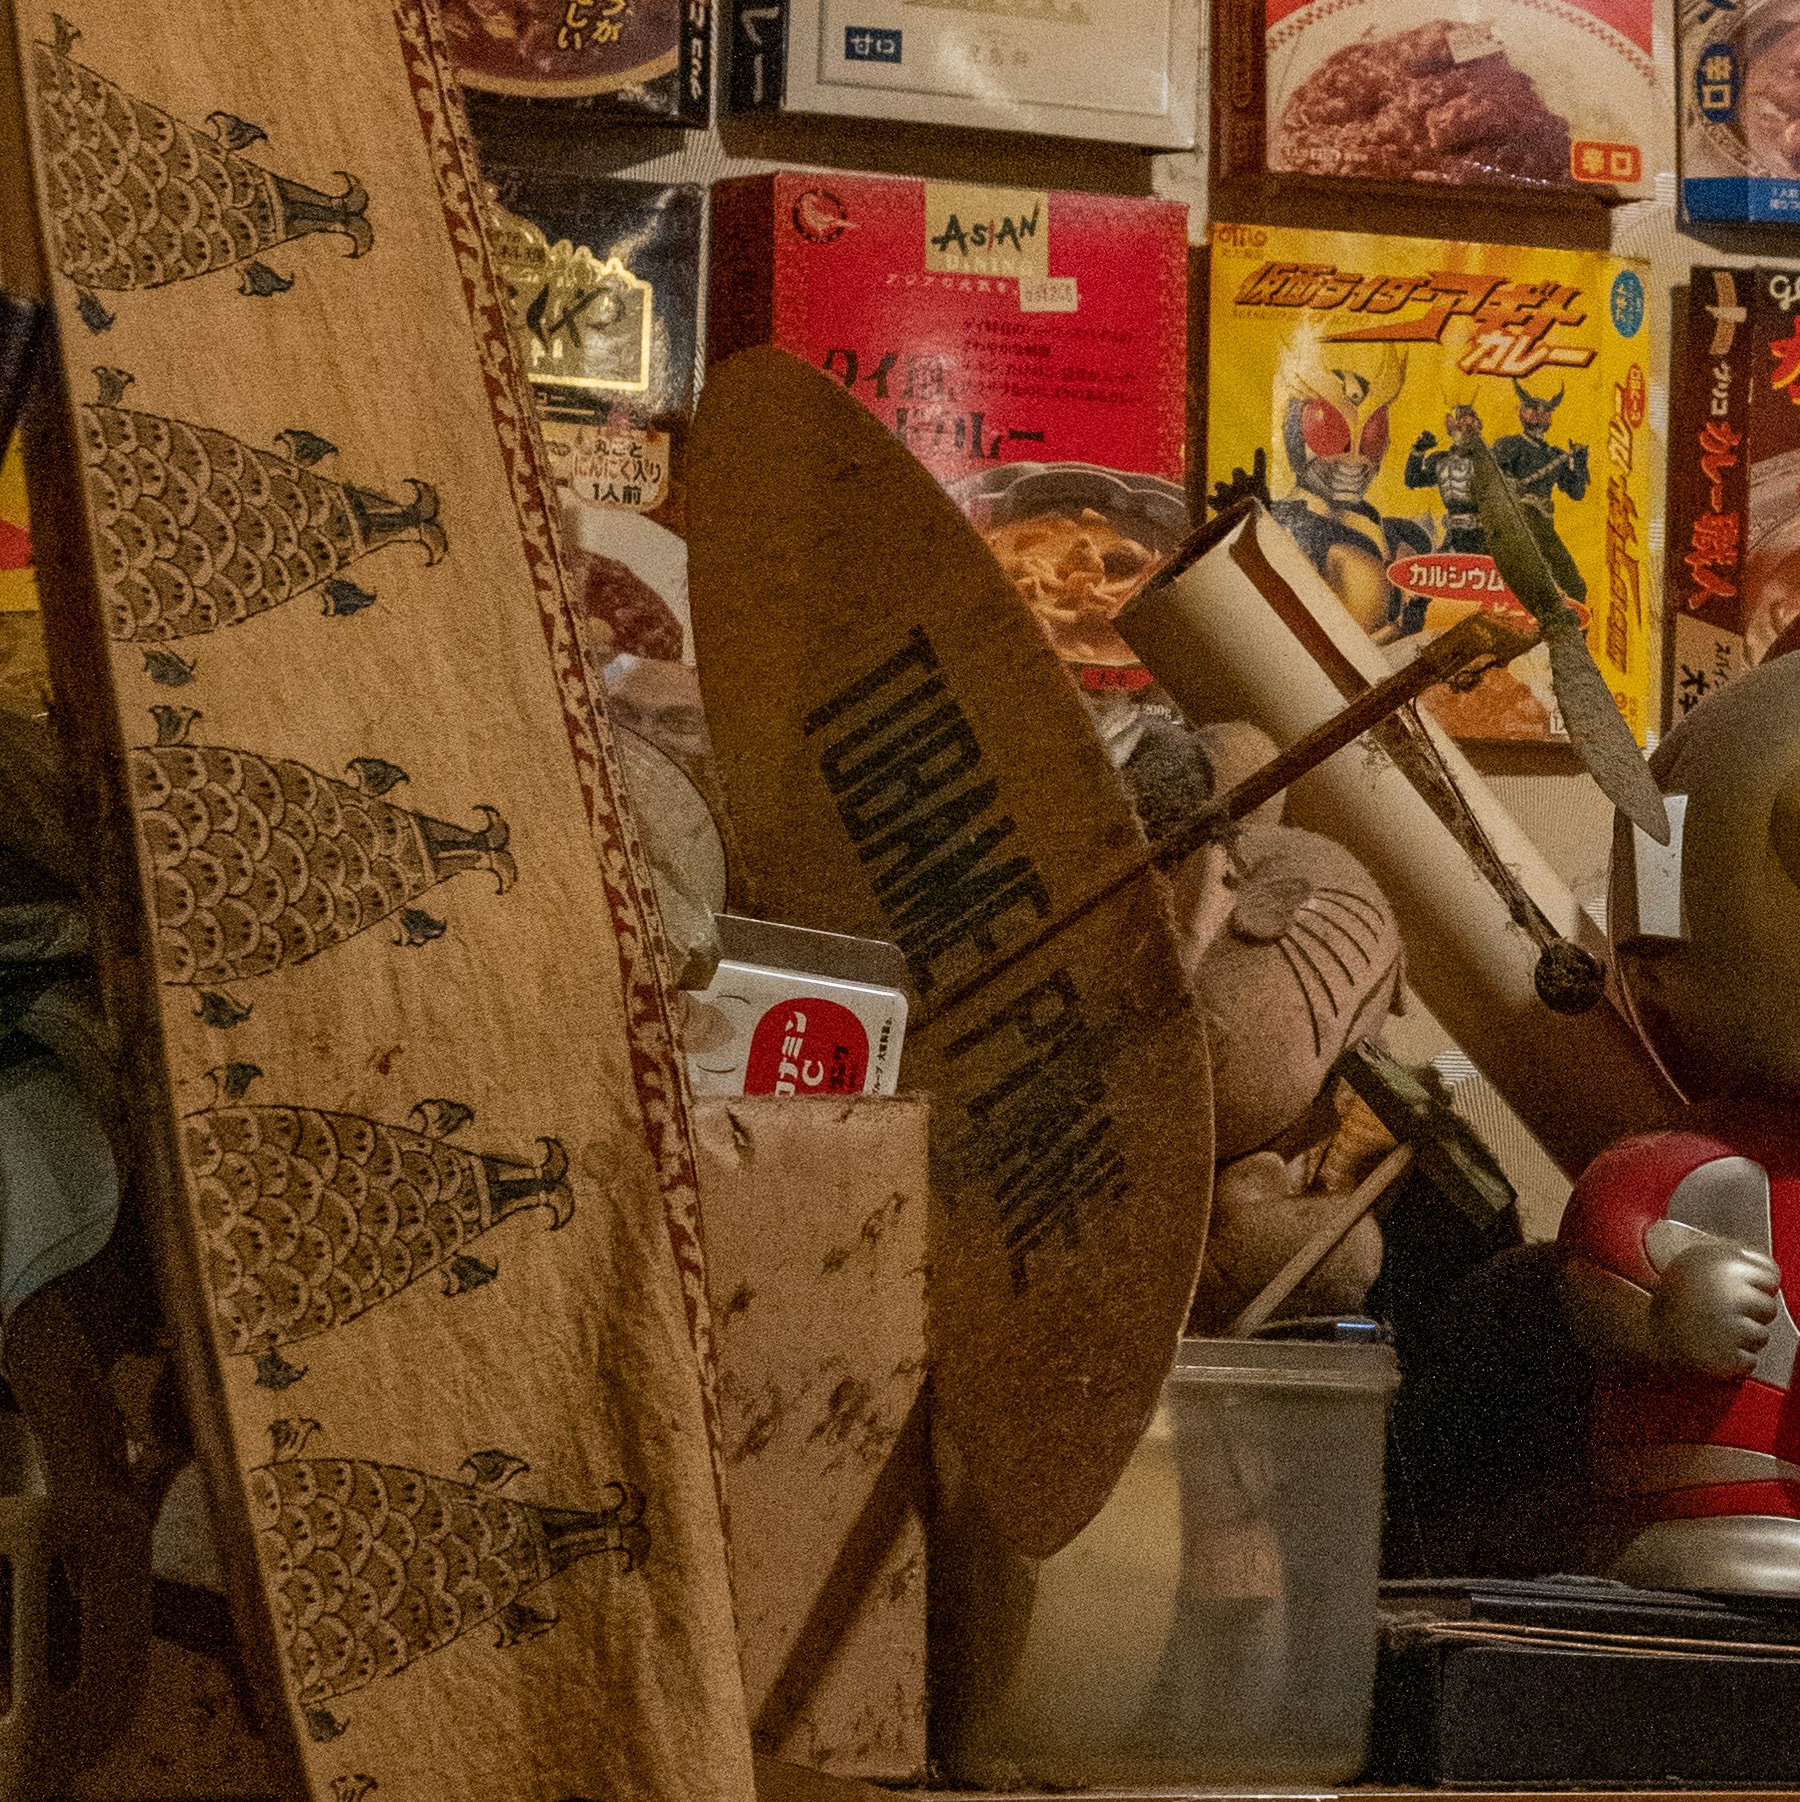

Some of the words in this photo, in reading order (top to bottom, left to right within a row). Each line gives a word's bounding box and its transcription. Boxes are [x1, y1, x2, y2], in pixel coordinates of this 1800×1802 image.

[1701, 55, 1733, 109] 辛口
[931, 200, 1041, 257] ASIAN
[1234, 263, 1438, 312] 仮面ライダー
[1461, 333, 1596, 377] カレー
[1710, 361, 1731, 417] グリコ
[592, 485, 642, 505] 1人前
[1685, 422, 1741, 610] カレー職人
[1409, 564, 1506, 591] カルシウム
[801, 1058, 826, 1087] C
